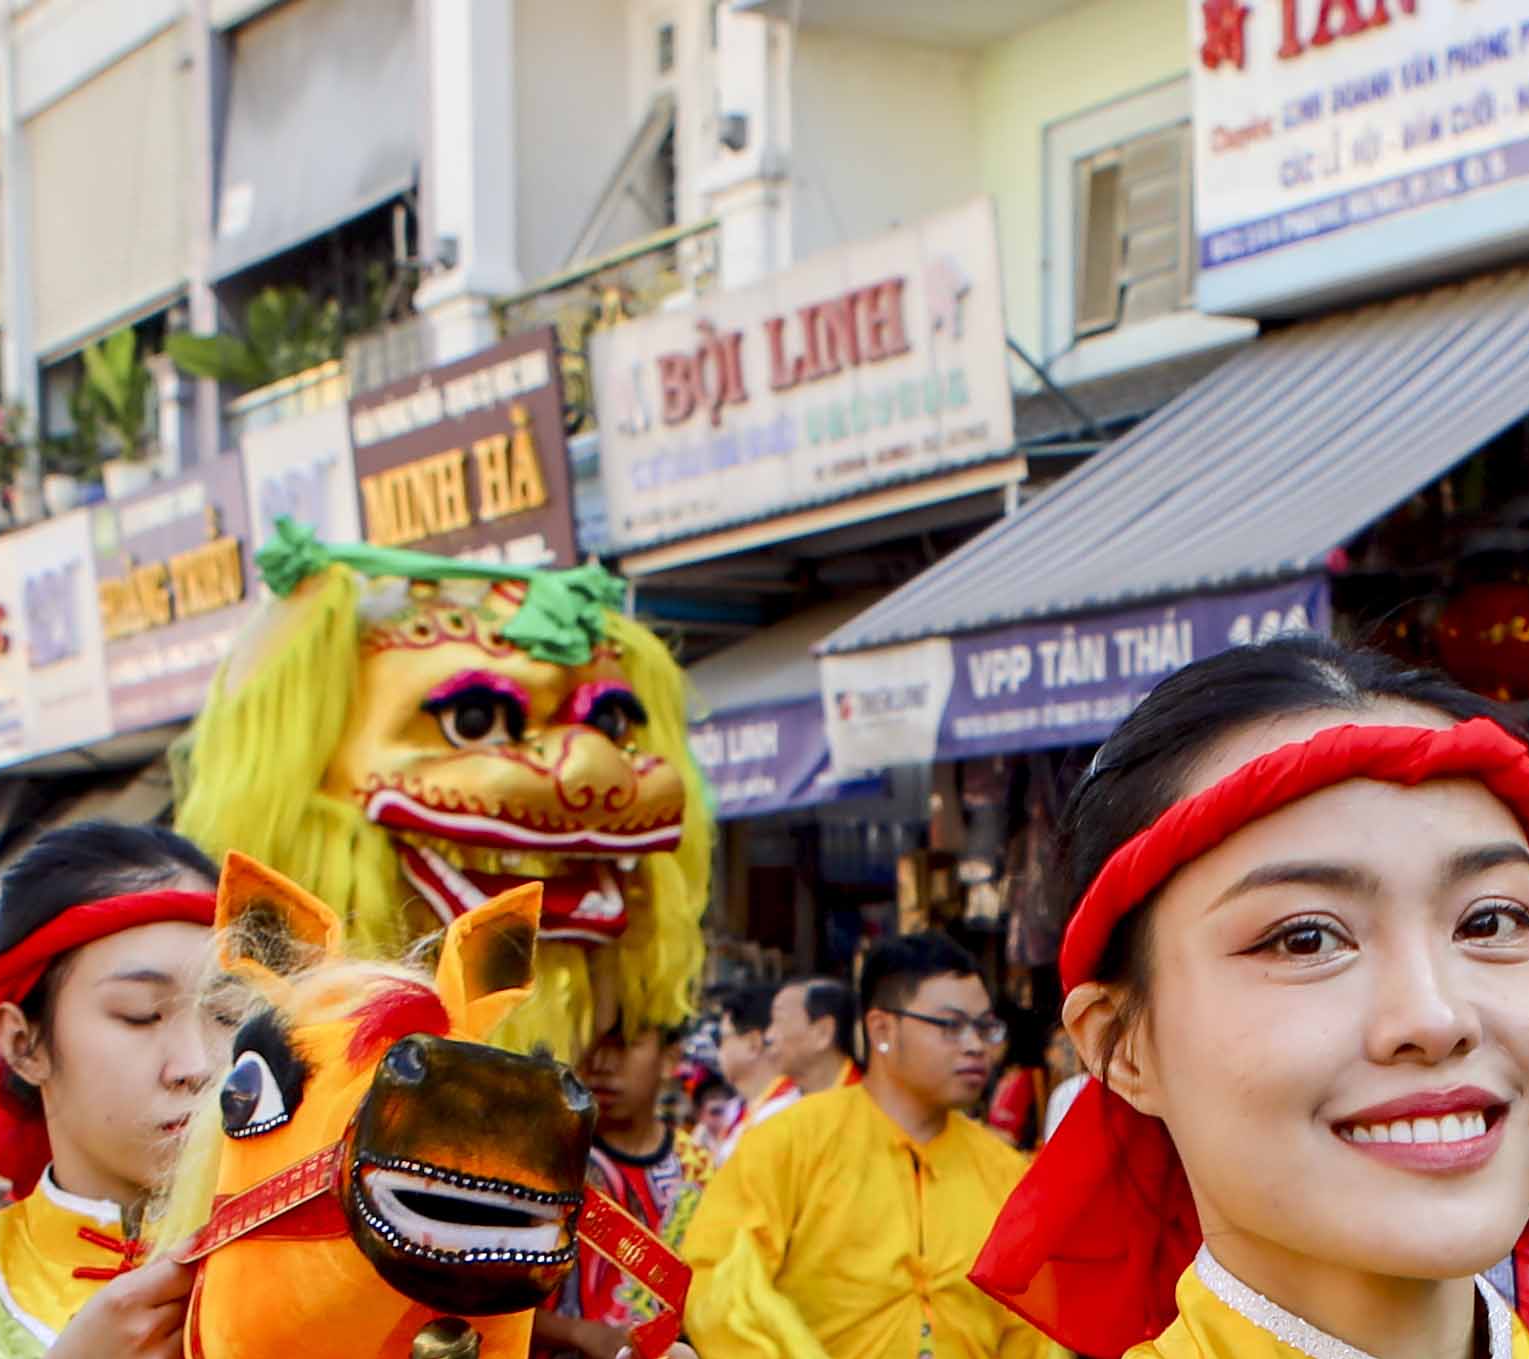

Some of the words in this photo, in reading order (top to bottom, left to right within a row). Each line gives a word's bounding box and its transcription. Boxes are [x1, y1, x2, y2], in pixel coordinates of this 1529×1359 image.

[763, 275, 912, 394] LINH
[360, 447, 470, 548] MINH
[967, 646, 1034, 699] VPP
[1036, 622, 1107, 688] TÂN
[1113, 608, 1195, 678] THÁI
